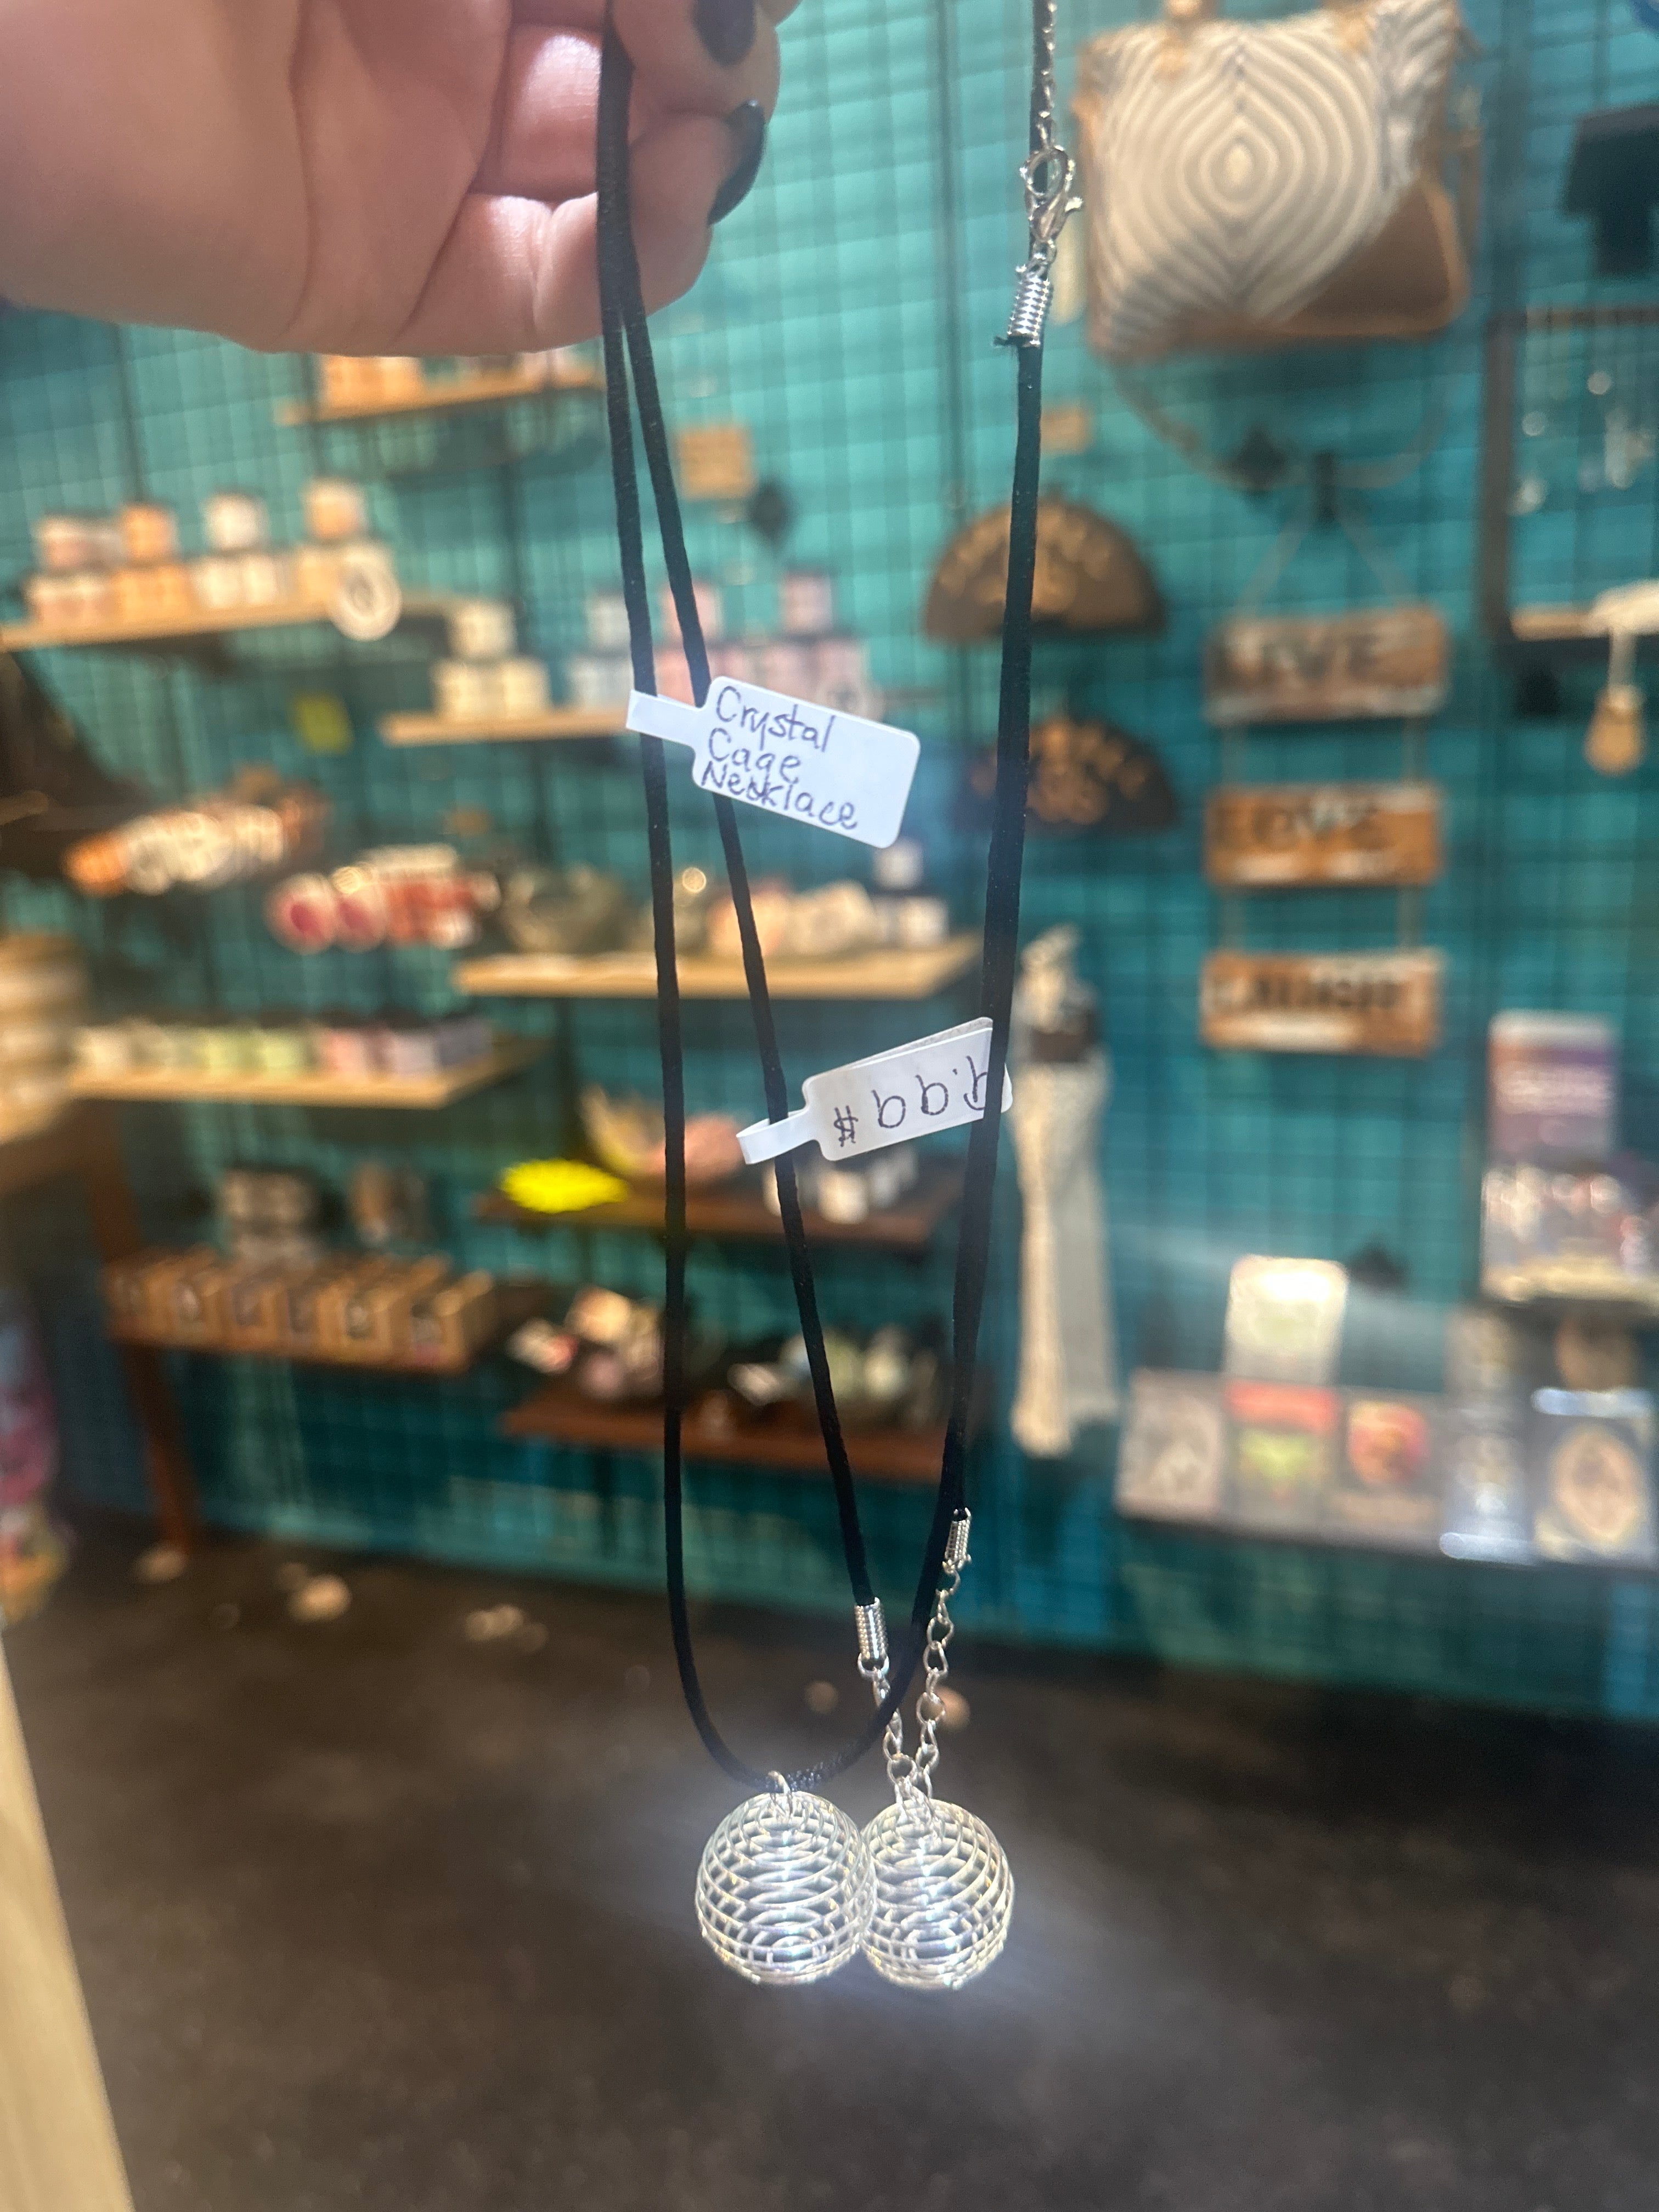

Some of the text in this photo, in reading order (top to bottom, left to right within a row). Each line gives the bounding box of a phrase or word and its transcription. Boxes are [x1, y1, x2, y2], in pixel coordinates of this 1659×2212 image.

[716, 685, 834, 753] Crystal
[708, 727, 801, 794] Cage
[701, 761, 858, 830] Necklace
